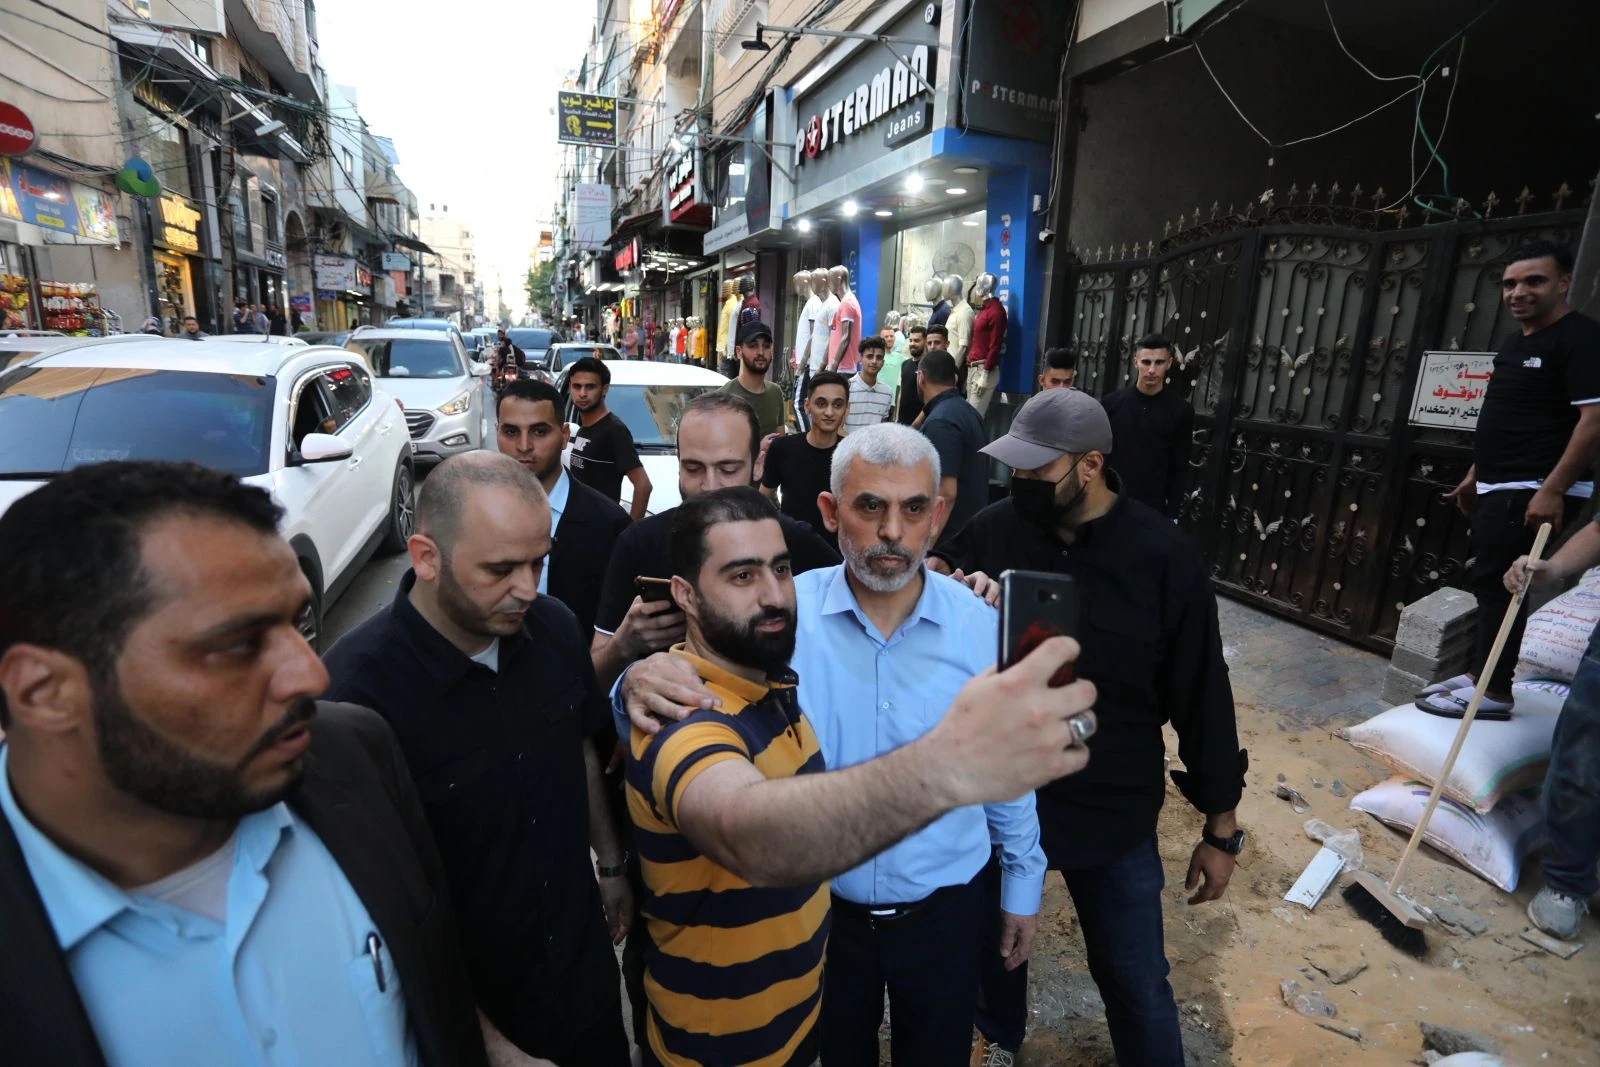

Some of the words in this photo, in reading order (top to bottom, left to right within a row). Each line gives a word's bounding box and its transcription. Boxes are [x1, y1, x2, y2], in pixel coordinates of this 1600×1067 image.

[561, 93, 582, 108] توب
[584, 96, 615, 112] كوافير
[795, 45, 928, 166] POSTERMAN
[887, 110, 921, 139] Jeans
[1457, 368, 1493, 382] جاء
[1432, 384, 1483, 401] الوقوف
[1460, 406, 1480, 419] كثير
